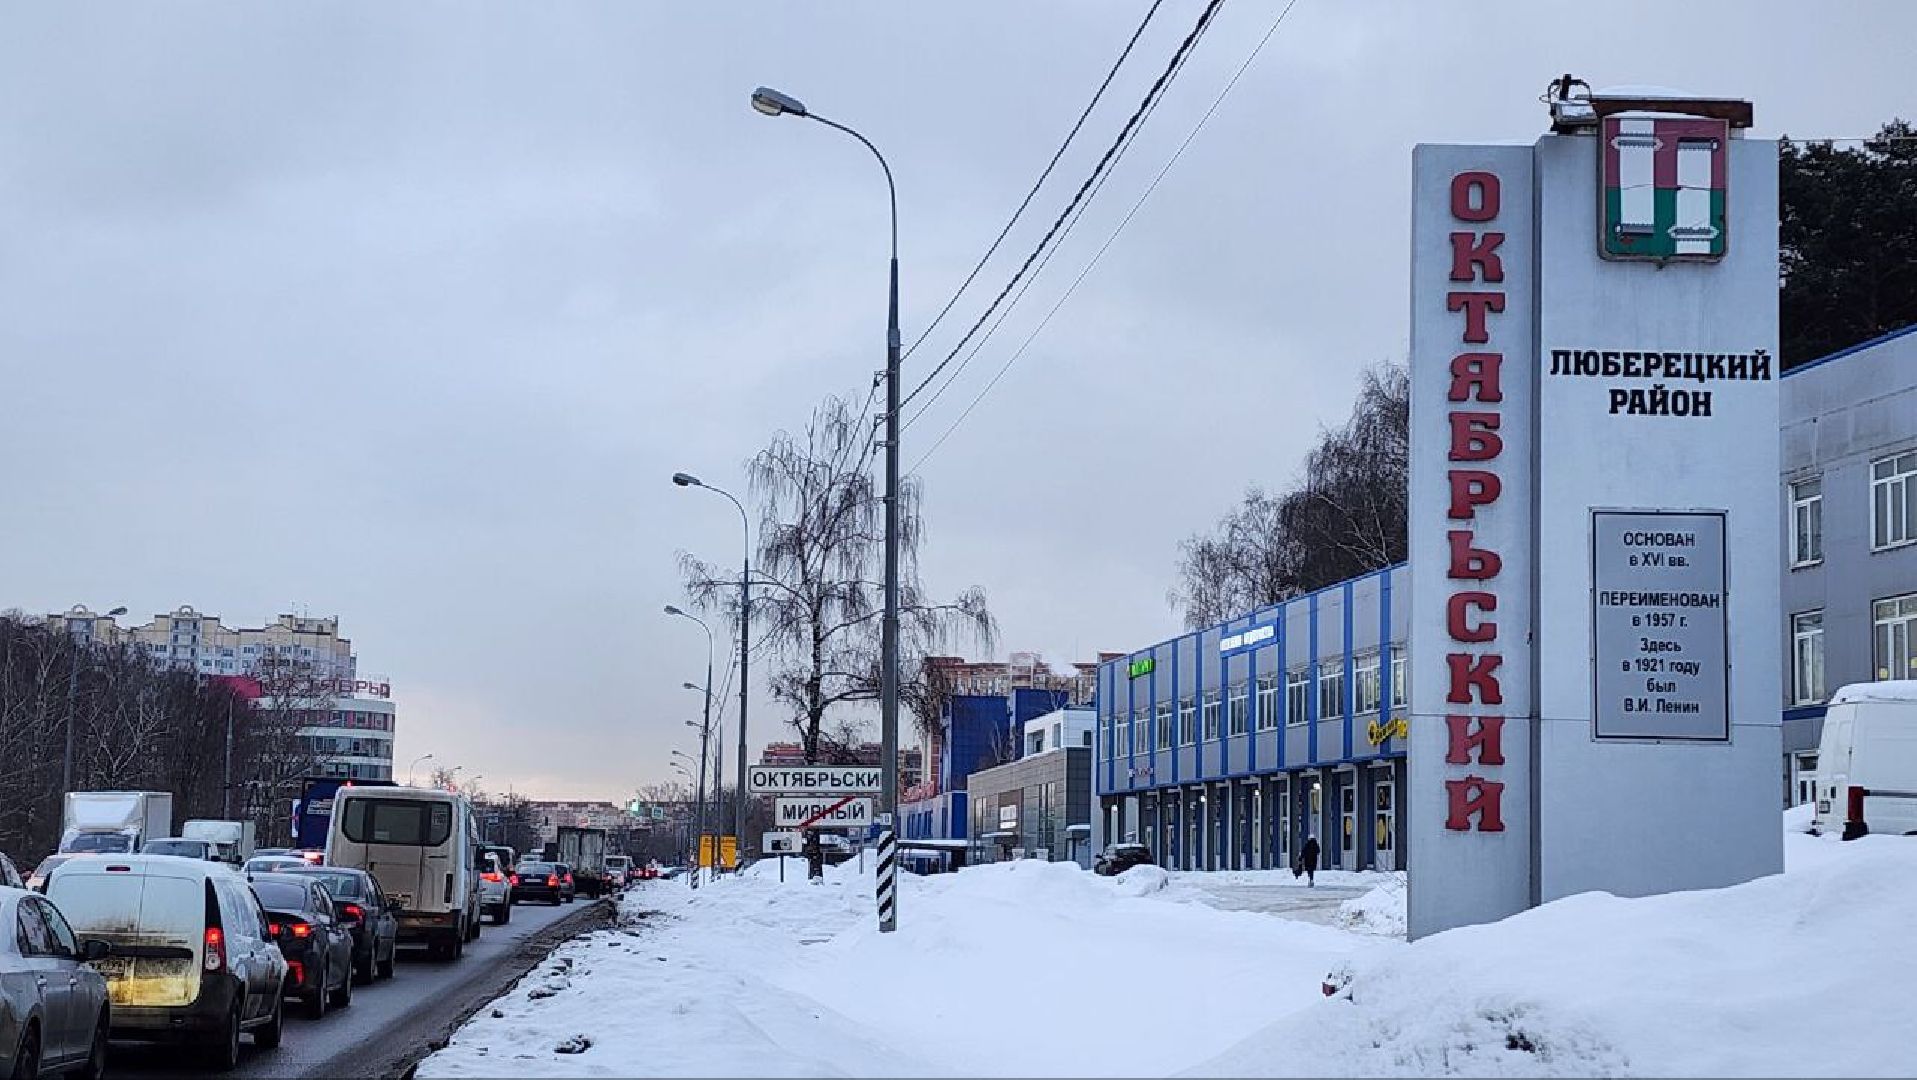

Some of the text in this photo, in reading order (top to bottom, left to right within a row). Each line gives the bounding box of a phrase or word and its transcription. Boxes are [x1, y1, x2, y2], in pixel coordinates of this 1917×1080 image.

[1549, 349, 1772, 384] ЛЮБЕРЕЦКИЙ
[1608, 384, 1712, 417] РАЙОН
[1445, 171, 1506, 832] ОКТЯБРЬСКИЙ
[1623, 532, 1696, 547] ОСНОВАН
[1629, 552, 1690, 567] в XVI вв.
[1600, 591, 1720, 608] ПЕРЕИМЕНОВАН
[1632, 614, 1688, 627] в 1957 г.
[1640, 638, 1682, 653] Здесь
[1622, 659, 1702, 677] в 1921 году
[1646, 678, 1676, 693] был
[1656, 699, 1700, 714] Ленин
[753, 771, 880, 787] ОКТЯБРЬСКИ
[782, 801, 865, 820] МИРНЫЙ
